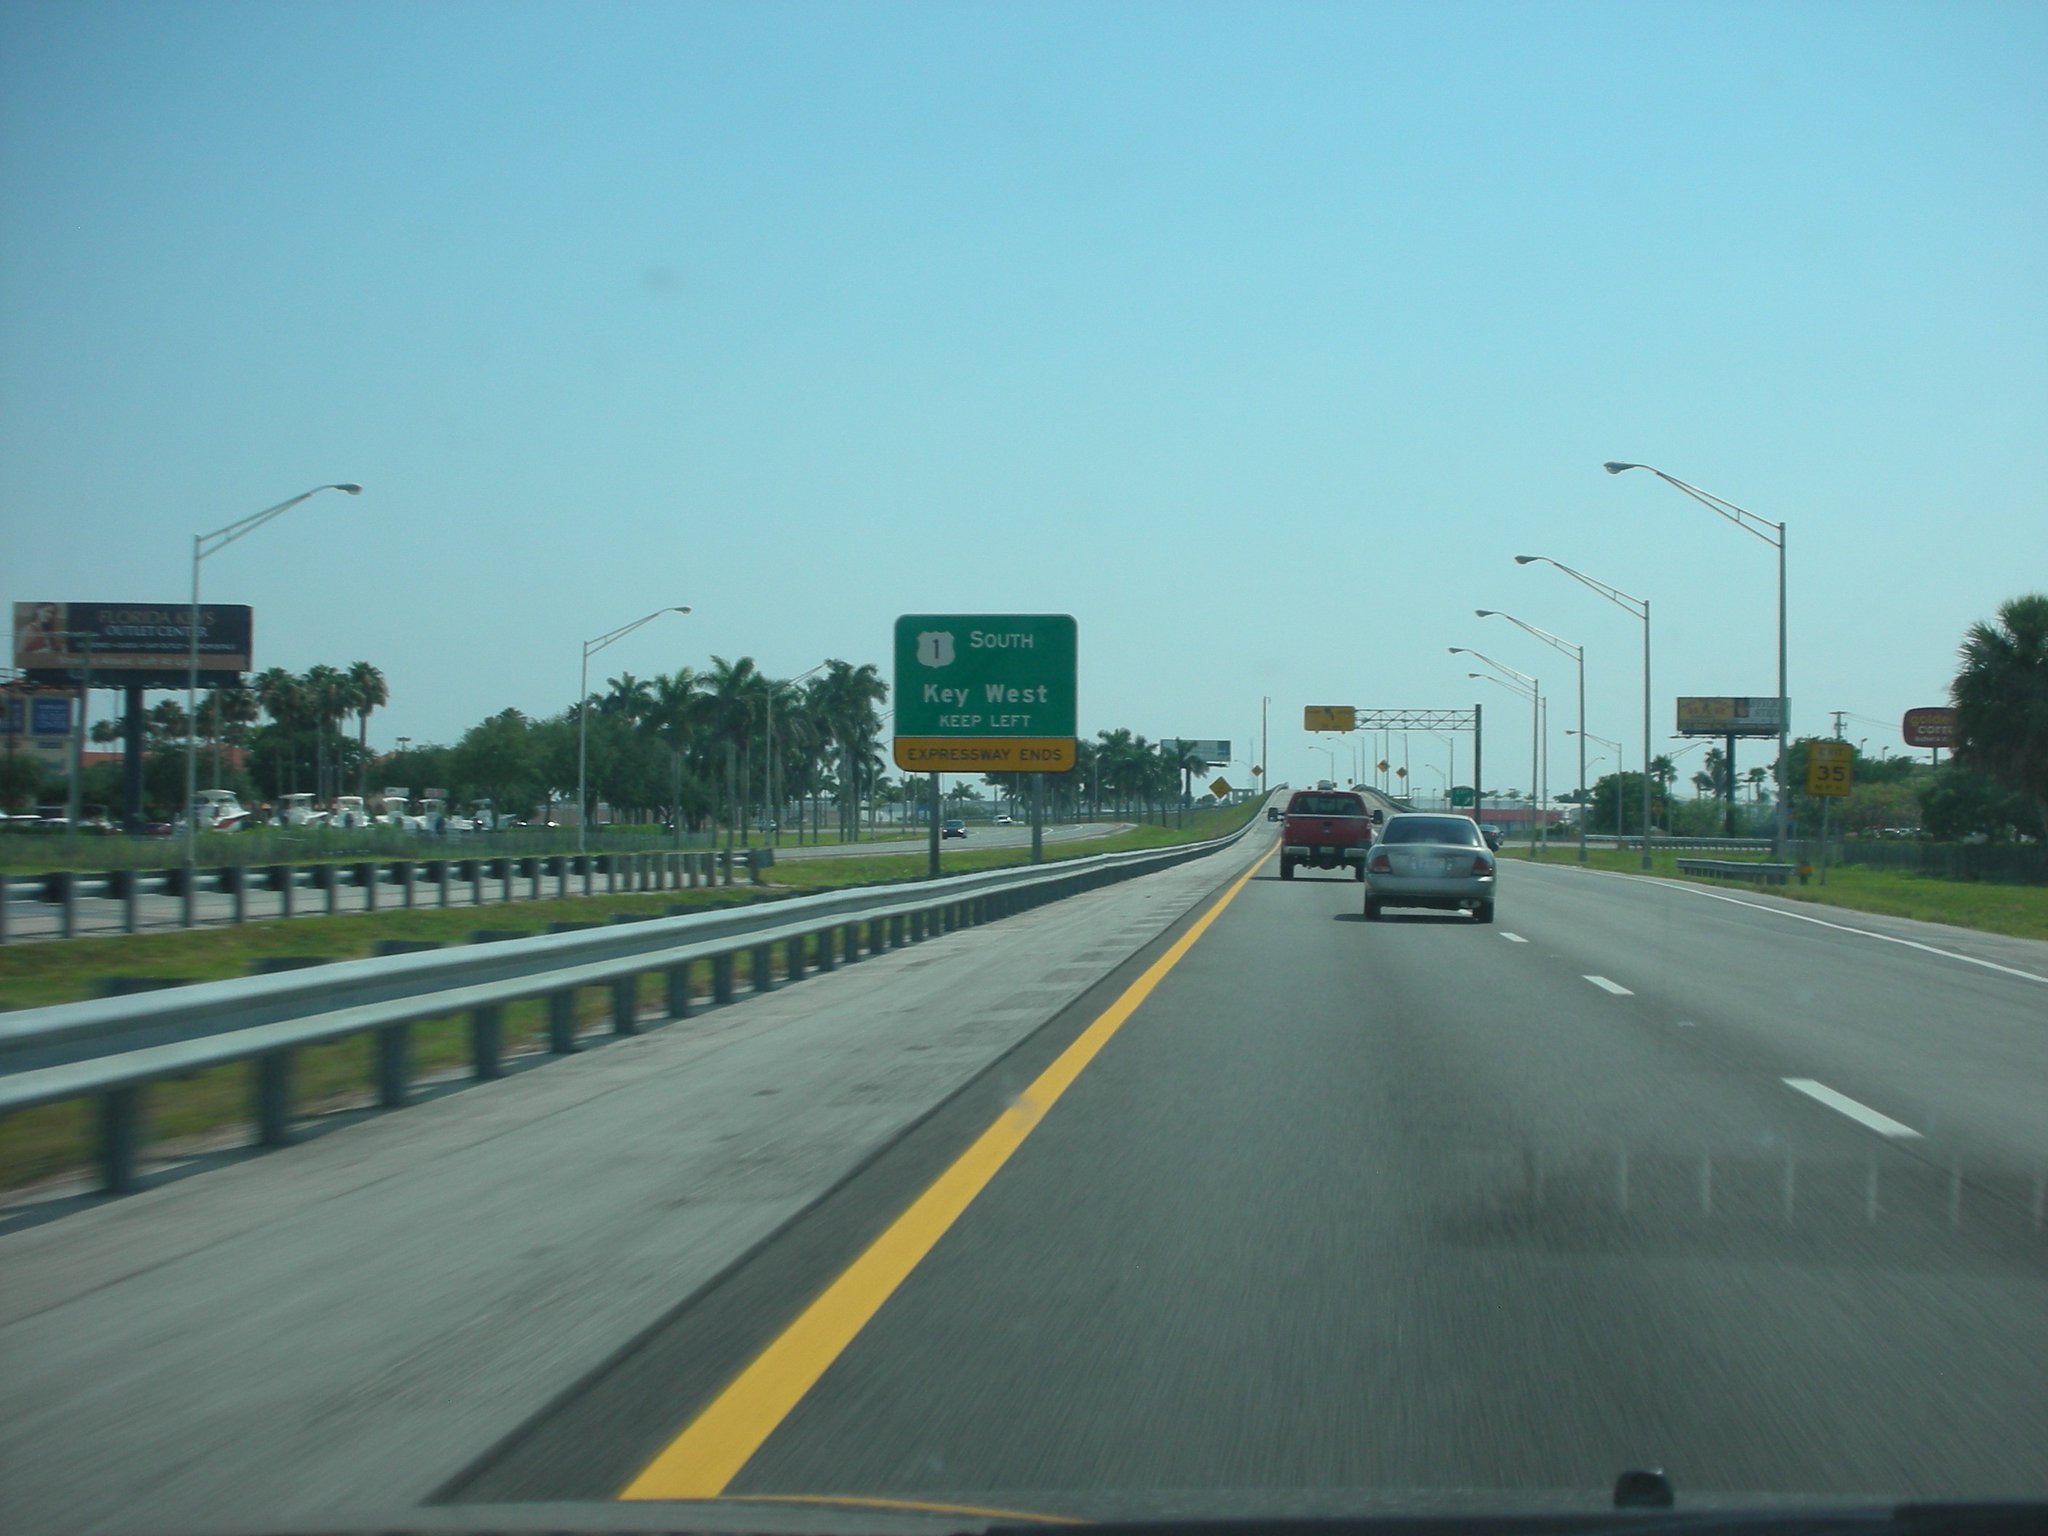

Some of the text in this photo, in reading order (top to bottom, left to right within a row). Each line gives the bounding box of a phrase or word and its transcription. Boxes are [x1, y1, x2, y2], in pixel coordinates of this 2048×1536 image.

[932, 638, 940, 660] 1
[924, 684, 1048, 708] Key West
[939, 714, 1031, 727] KEEP LEFT
[907, 748, 1063, 760] EXPRESSWAY ENDS
[1817, 766, 1845, 781] 35
